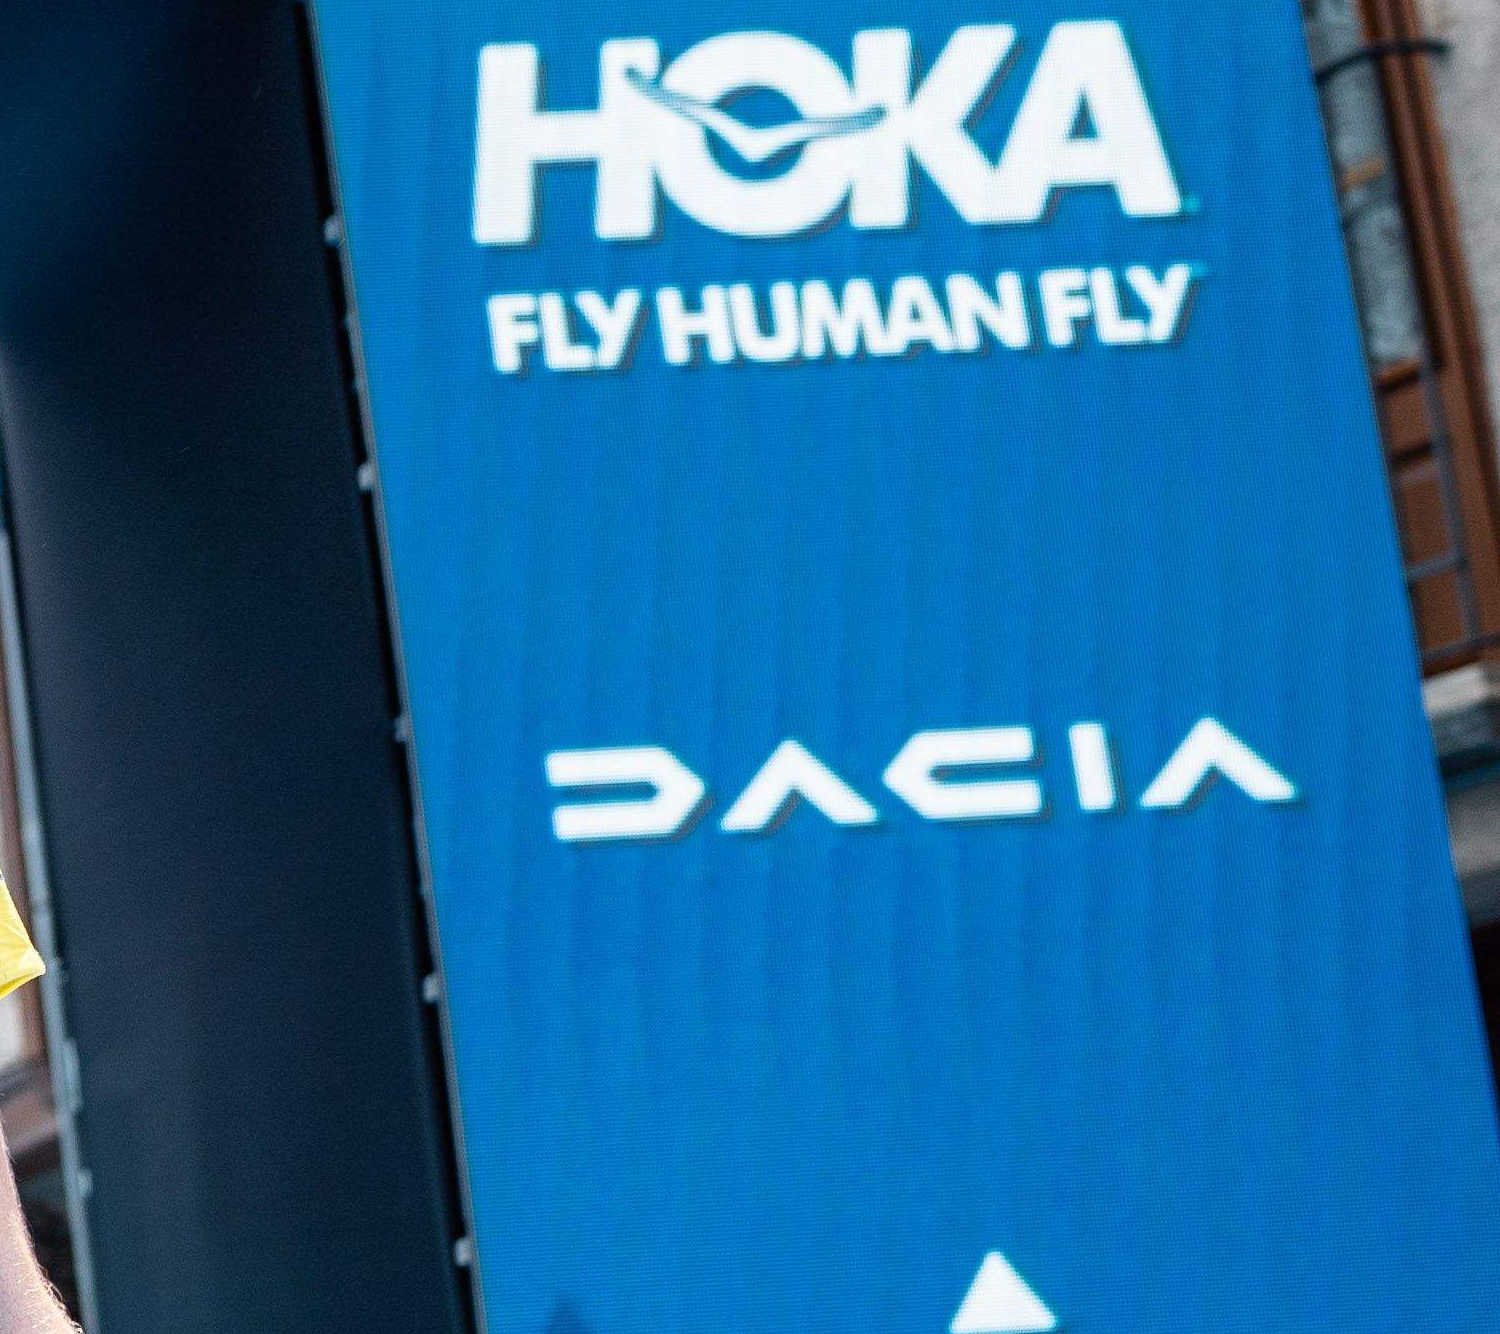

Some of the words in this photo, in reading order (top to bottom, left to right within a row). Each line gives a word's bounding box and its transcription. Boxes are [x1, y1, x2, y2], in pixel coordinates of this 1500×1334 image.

[472, 18, 1182, 247] HOKA
[484, 288, 641, 375] FLY
[657, 270, 1031, 366] HUMAN
[1039, 263, 1192, 349] FLY
[544, 717, 1297, 843] DACIA
